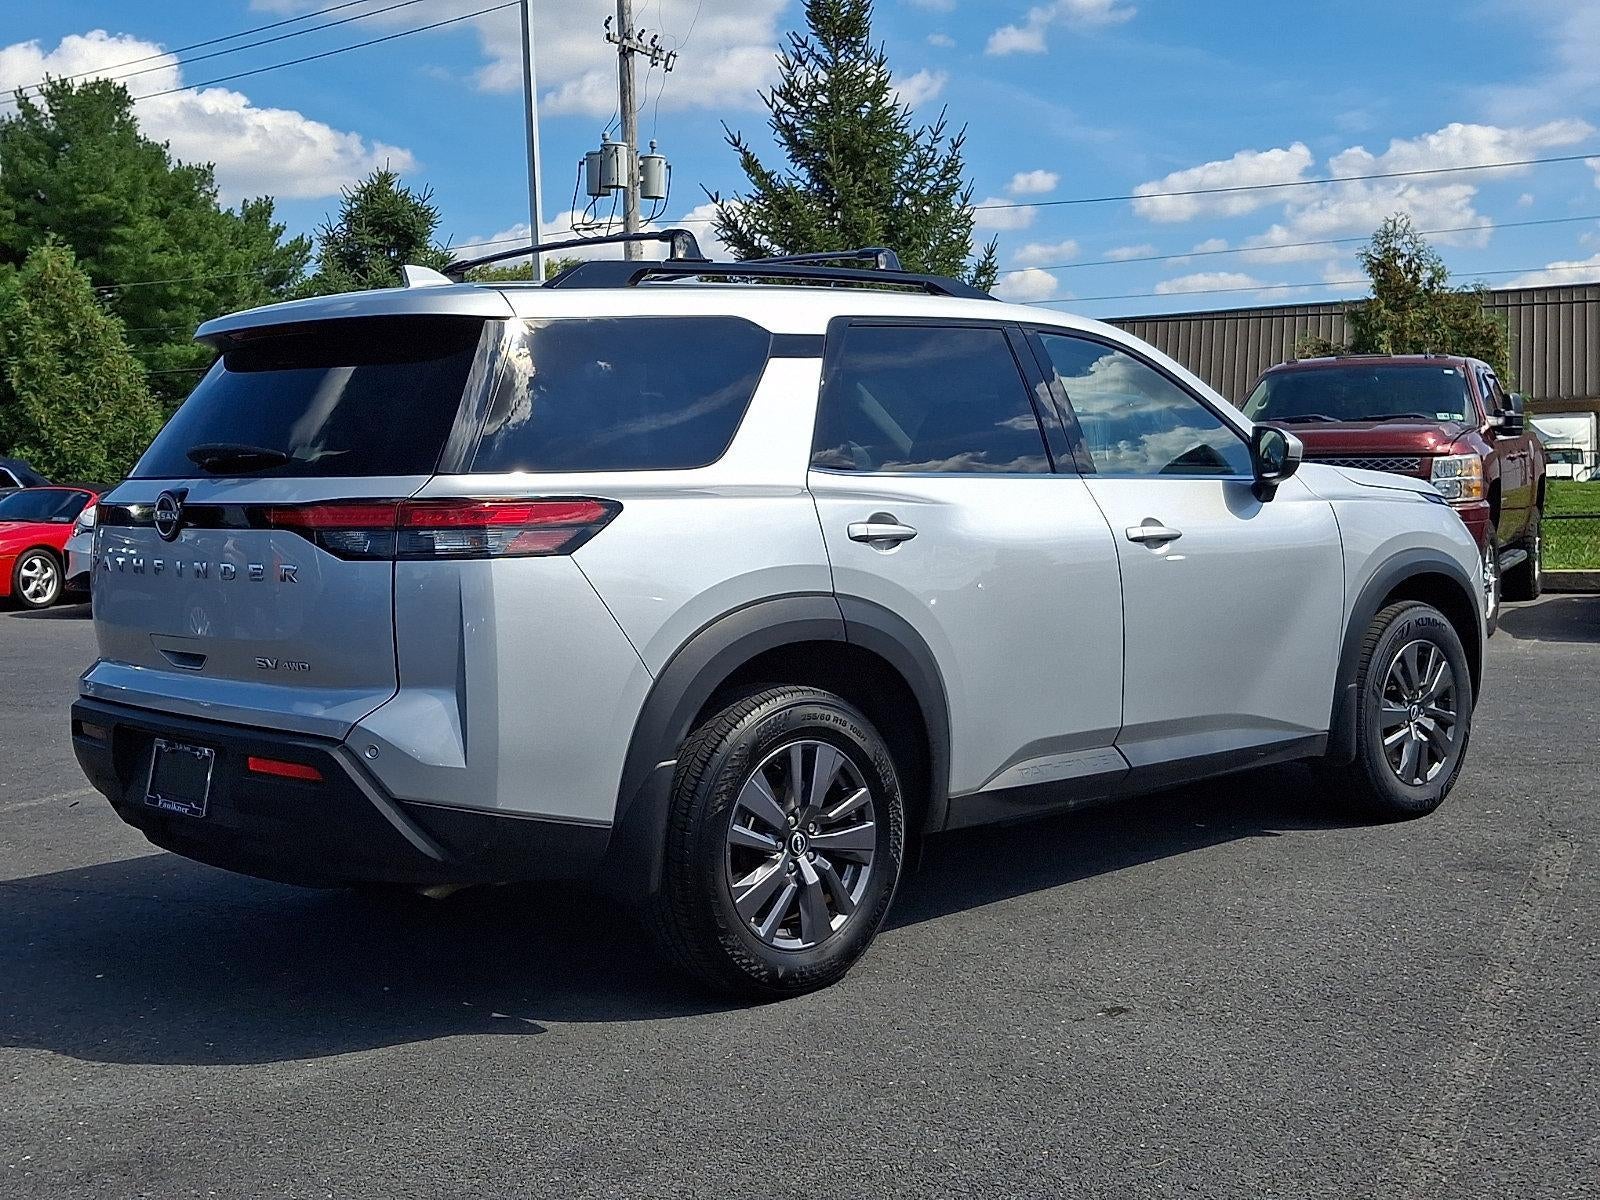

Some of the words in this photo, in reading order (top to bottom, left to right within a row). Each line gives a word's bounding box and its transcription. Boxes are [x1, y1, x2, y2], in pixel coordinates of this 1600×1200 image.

[153, 510, 178, 520] SSAN
[255, 656, 278, 670] SV
[282, 661, 310, 671] 4WD
[801, 712, 831, 722] 255/60
[832, 715, 848, 727] R18
